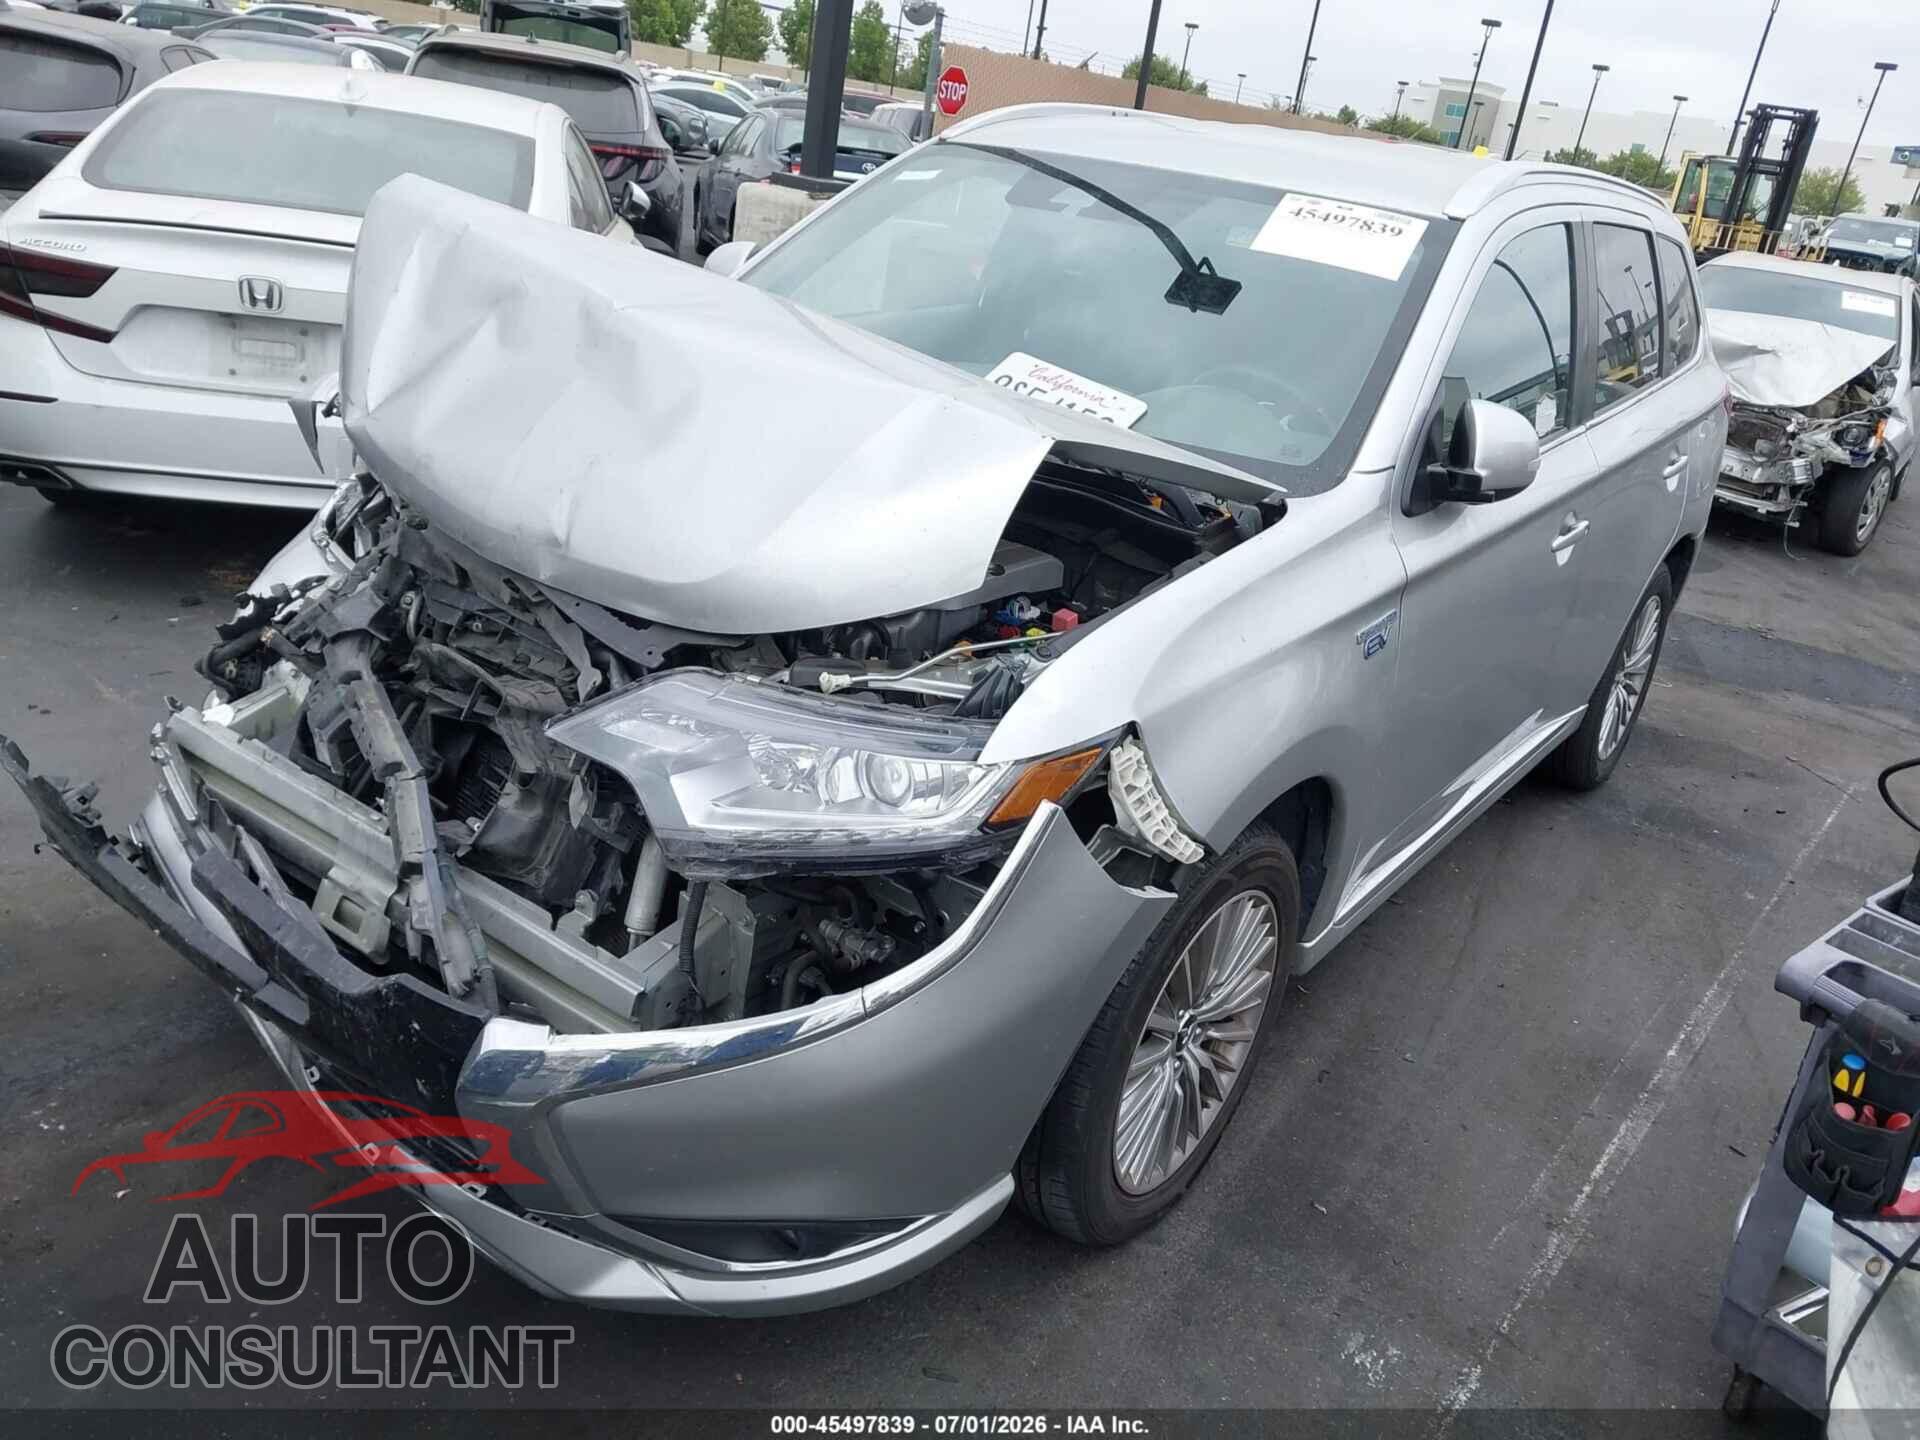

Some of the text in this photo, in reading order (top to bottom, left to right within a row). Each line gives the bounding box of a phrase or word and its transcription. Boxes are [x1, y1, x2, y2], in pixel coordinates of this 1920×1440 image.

[940, 80, 967, 101] STOP
[1288, 207, 1403, 237] 45497839
[17, 238, 87, 252] ACCORD
[1028, 367, 1108, 408] California
